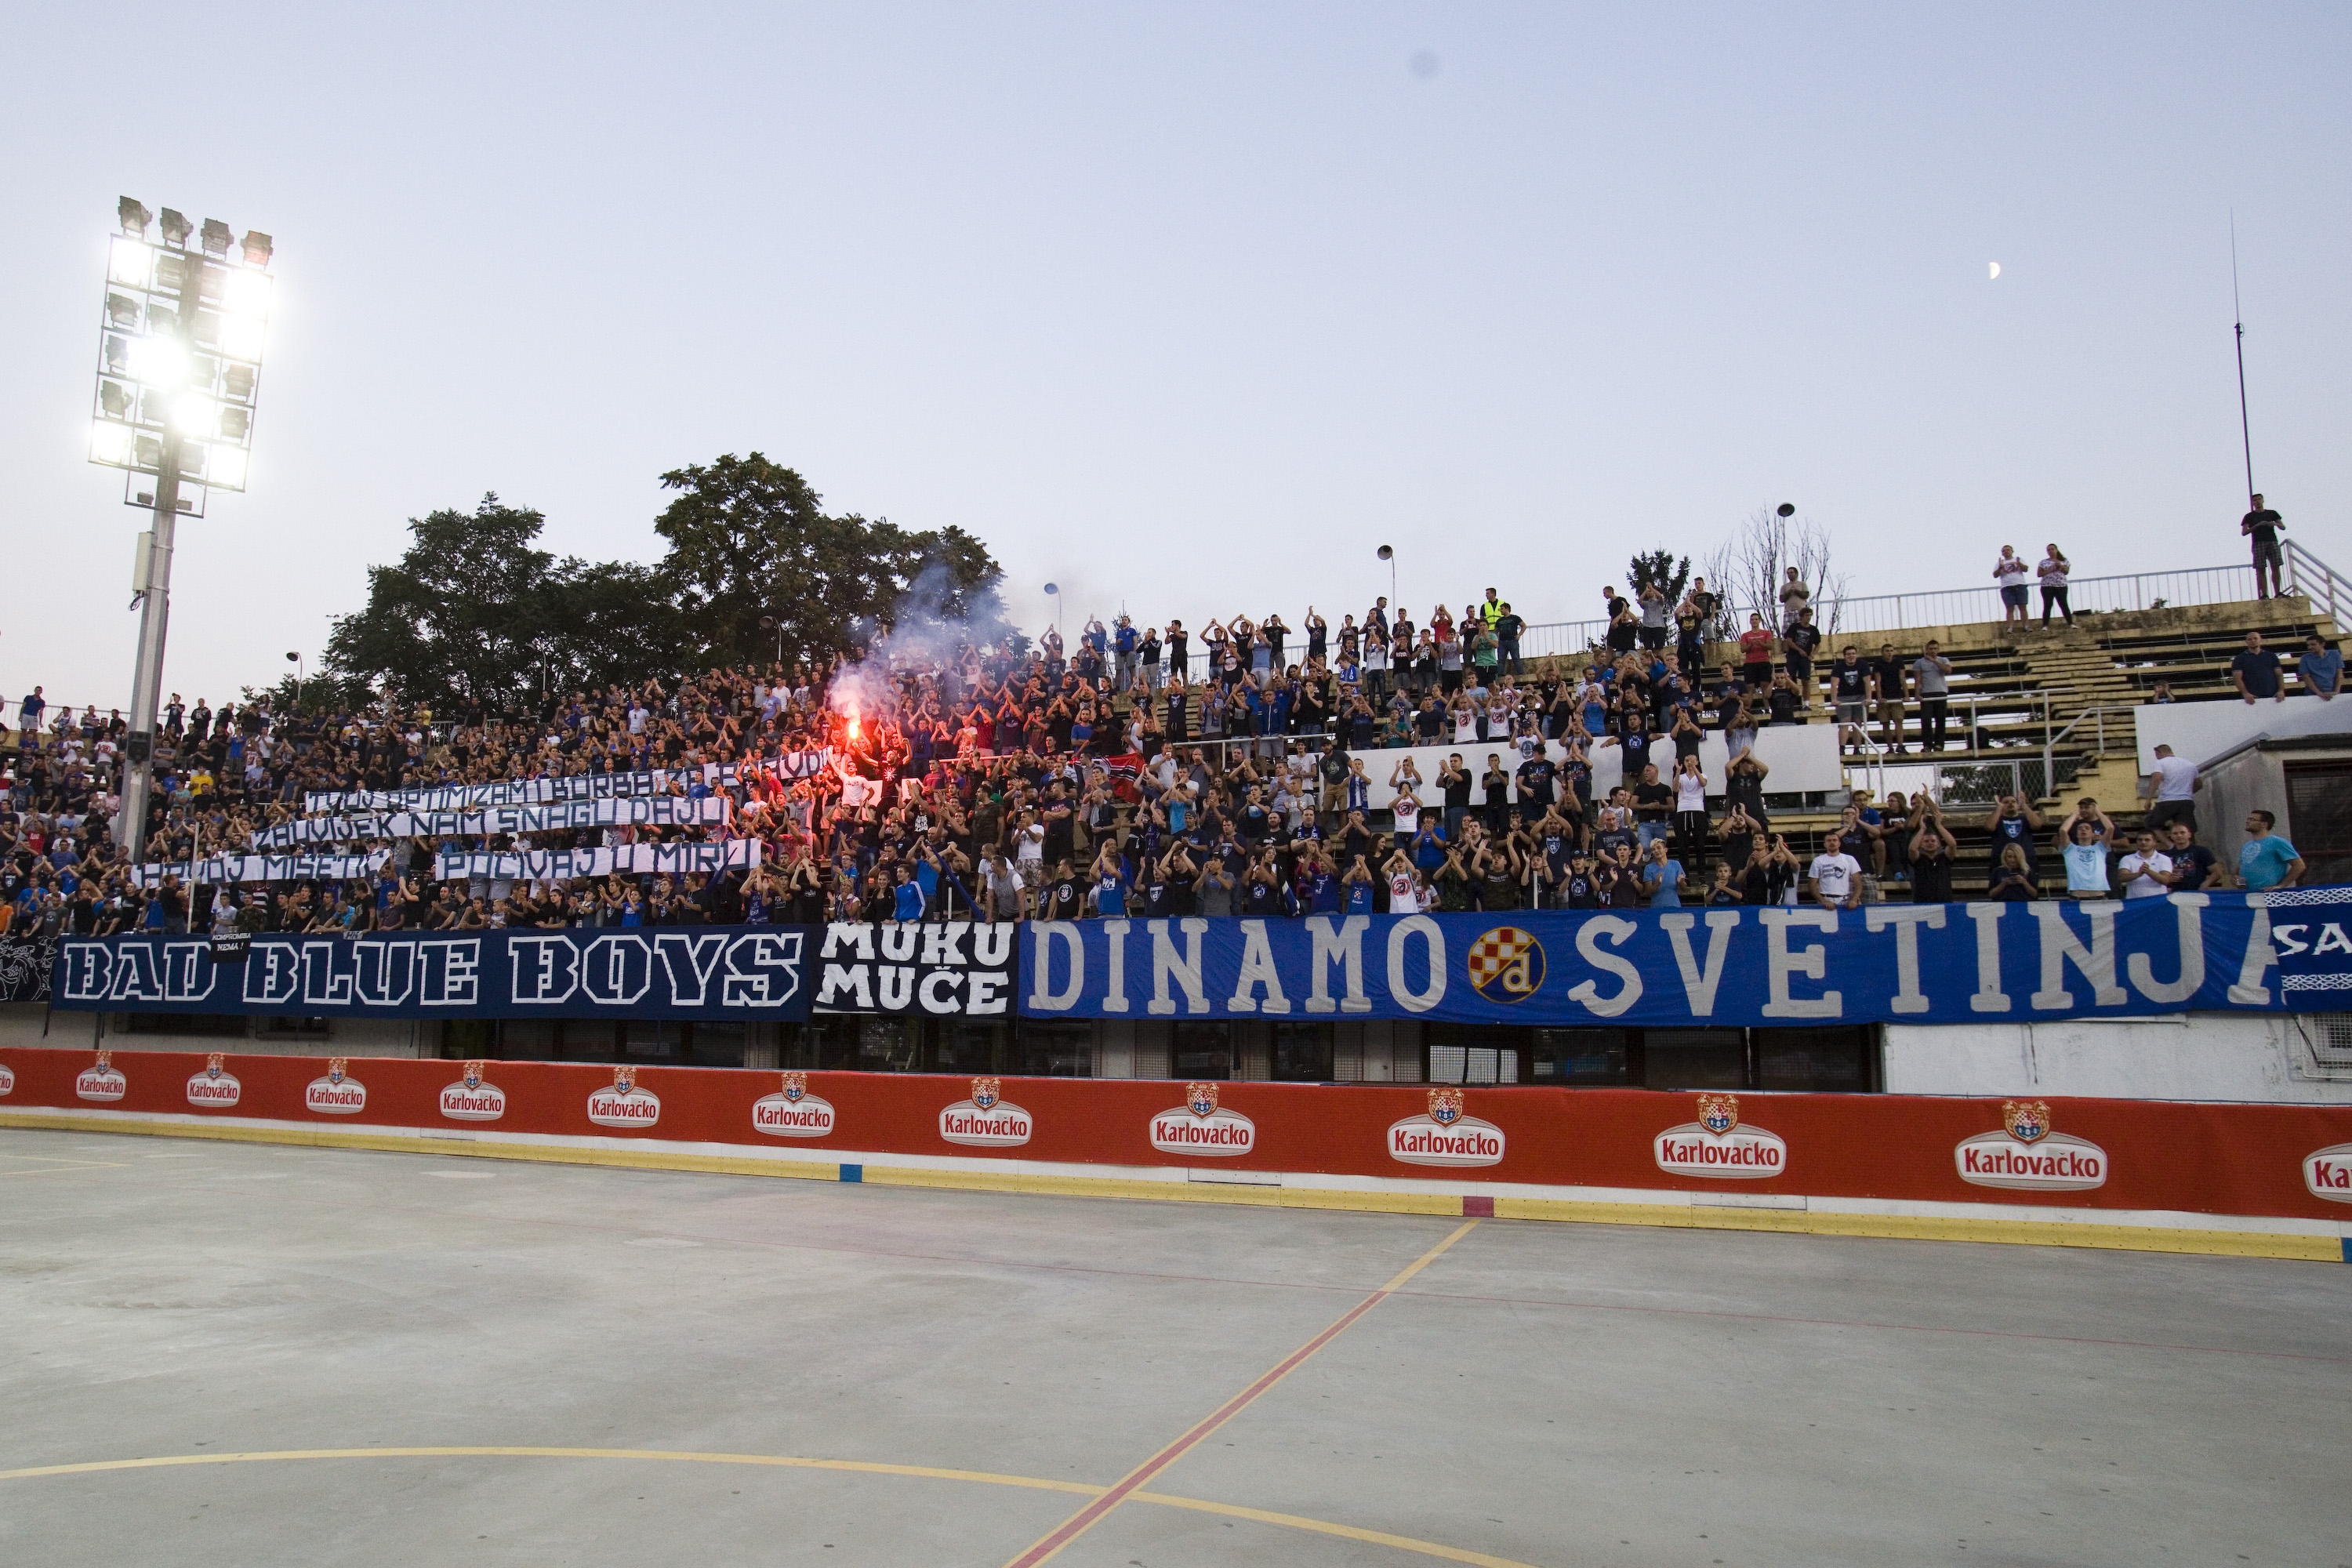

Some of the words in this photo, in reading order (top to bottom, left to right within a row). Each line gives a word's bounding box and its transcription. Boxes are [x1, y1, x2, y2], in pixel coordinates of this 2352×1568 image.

[387, 782, 527, 810] OPTIMIZAM
[550, 772, 653, 804] BORBA
[716, 749, 829, 786] PAVD
[255, 812, 399, 851] ZAUVIJEK
[410, 811, 485, 835] NAM
[497, 798, 617, 833] SNAGU
[629, 796, 724, 825] DAJU
[611, 844, 635, 874] U
[651, 839, 751, 873] MIRU
[212, 932, 251, 941] KOMPROMISA
[217, 942, 238, 951] NEMA
[820, 921, 1014, 966] MUKU
[1028, 914, 1447, 1014] DINAMO
[1568, 891, 2286, 1018] SVETINJA
[64, 941, 218, 1002] BAD
[242, 938, 481, 1007] BLUE
[508, 933, 804, 1007] BOYS
[815, 964, 1010, 1014] MUČE
[309, 1087, 363, 1105] Karlovačko
[444, 1092, 502, 1112] Karlovačko
[592, 1098, 656, 1119] Karlovačko
[757, 1105, 830, 1127] Karlovačko
[945, 1113, 1028, 1137] Karlovačko
[1156, 1121, 1250, 1145] Karlovačko
[1395, 1130, 1499, 1156] Karlovačko
[1662, 1139, 1780, 1167] Karlovačko
[1964, 1147, 2100, 1178] Karlovačko
